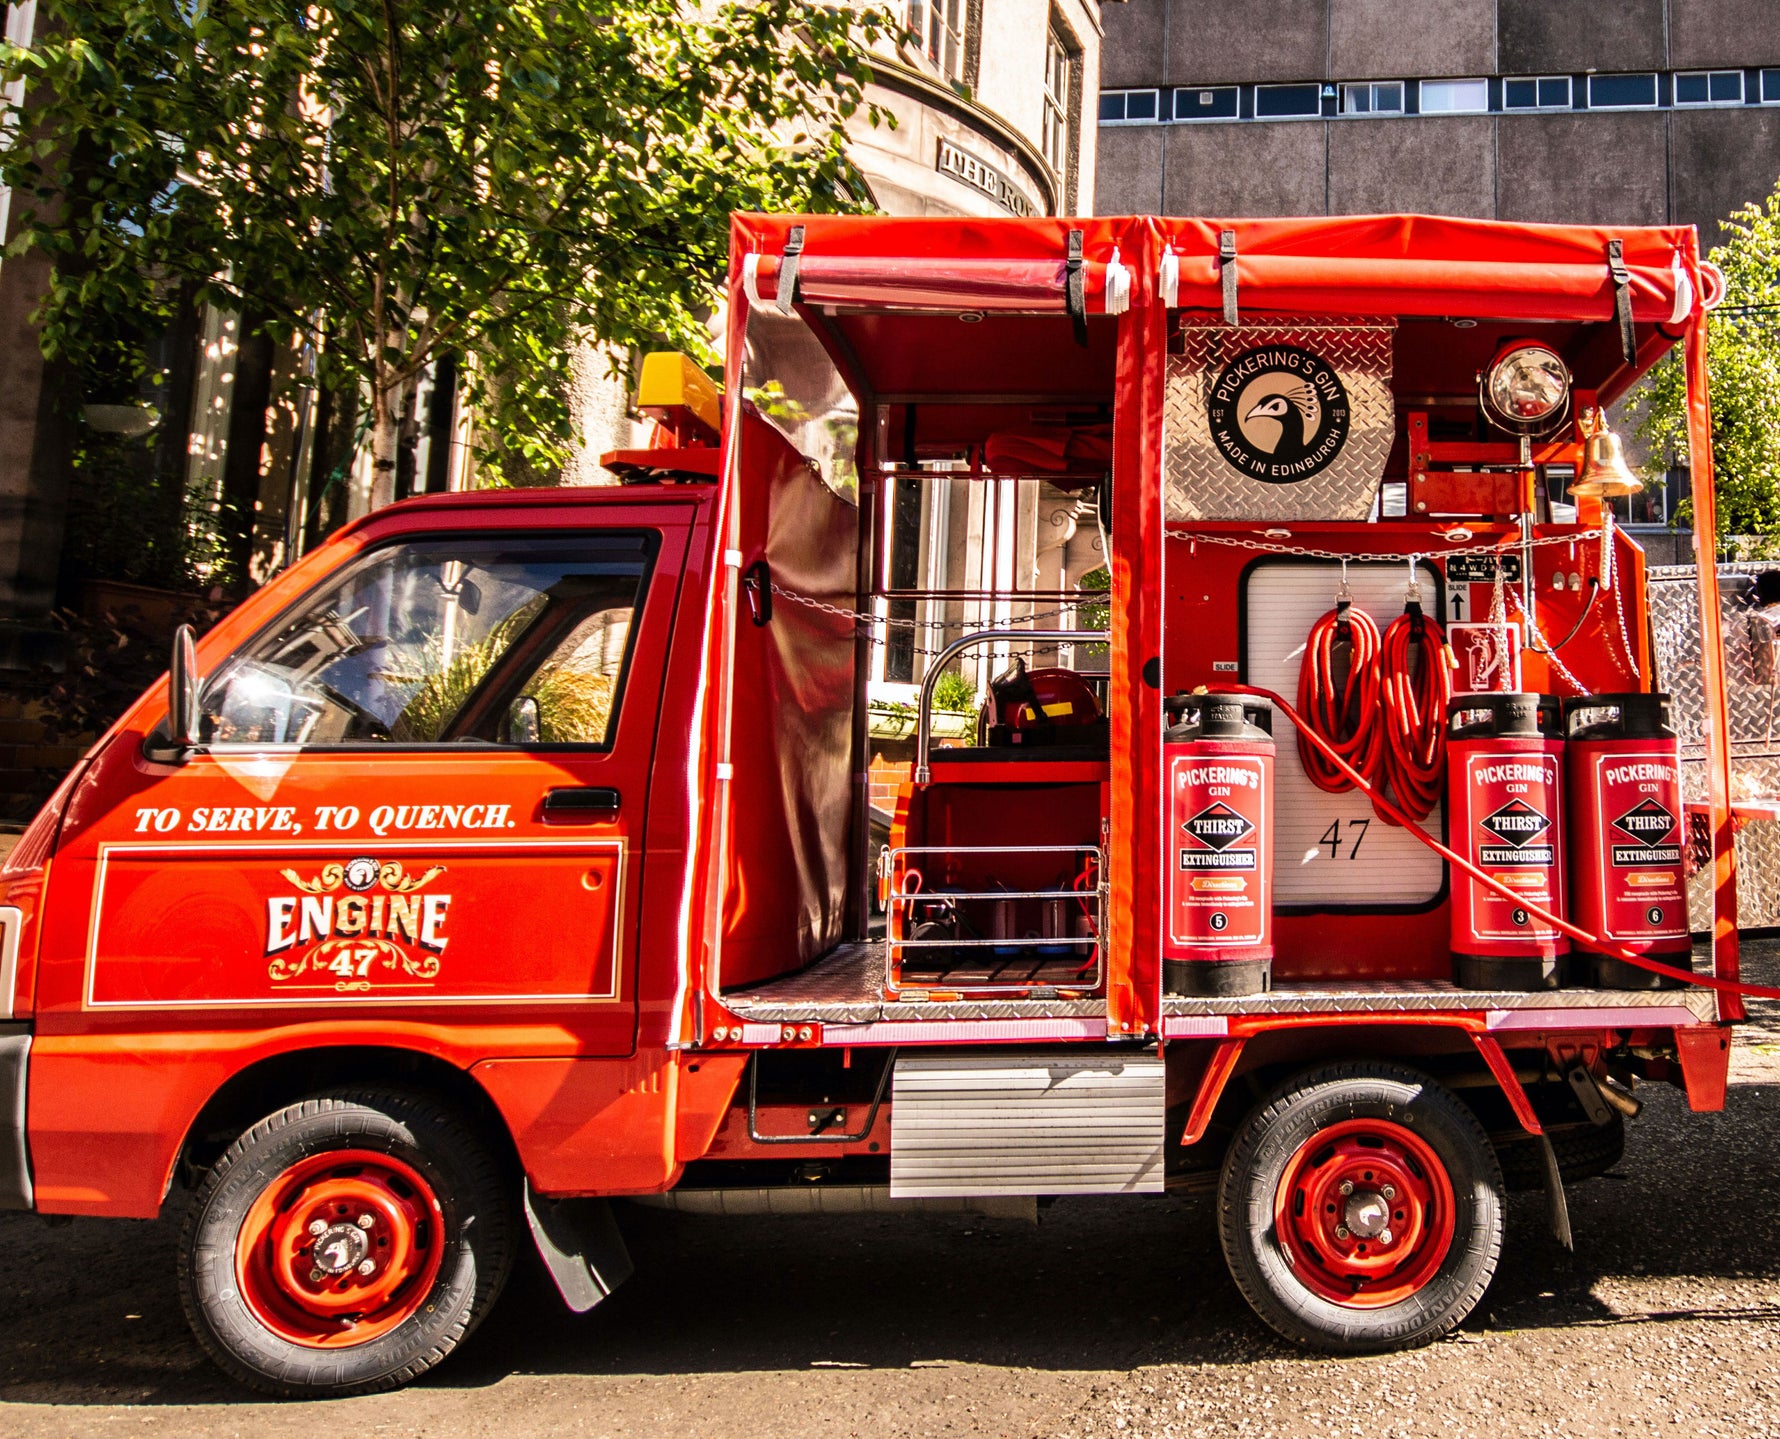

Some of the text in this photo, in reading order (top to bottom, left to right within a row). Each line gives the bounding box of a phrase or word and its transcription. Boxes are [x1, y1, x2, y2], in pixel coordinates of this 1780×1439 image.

[941, 142, 1036, 217] THE ROY
[1217, 351, 1340, 402] PICKERING'S GIN
[1212, 409, 1224, 417] EST
[1332, 409, 1346, 417] 2013
[1217, 428, 1341, 476] MADE IN EDINBURGH
[1178, 766, 1259, 790] PICKERING'S
[1475, 764, 1554, 786] PICKERING'S
[1606, 764, 1678, 786] PICKERING'S
[1208, 786, 1231, 797] GIN
[1506, 783, 1528, 793] GIN
[1638, 783, 1659, 793] GIN
[135, 804, 516, 836] TO SERVE, TO QUENCH.
[1193, 819, 1245, 835] THIRST
[1492, 816, 1543, 831] THIRST
[1625, 816, 1671, 830] THIRST
[1319, 818, 1370, 860] 47
[1182, 853, 1254, 867] EXTINGUISHER
[1482, 850, 1552, 862] EXTINGUISHER
[1615, 849, 1680, 862] EXTINGUISHER
[1215, 915, 1223, 928] 5
[1517, 910, 1525, 922] 3
[1652, 910, 1659, 922] 6
[266, 894, 451, 955] ENGINE
[328, 949, 379, 978] 47
